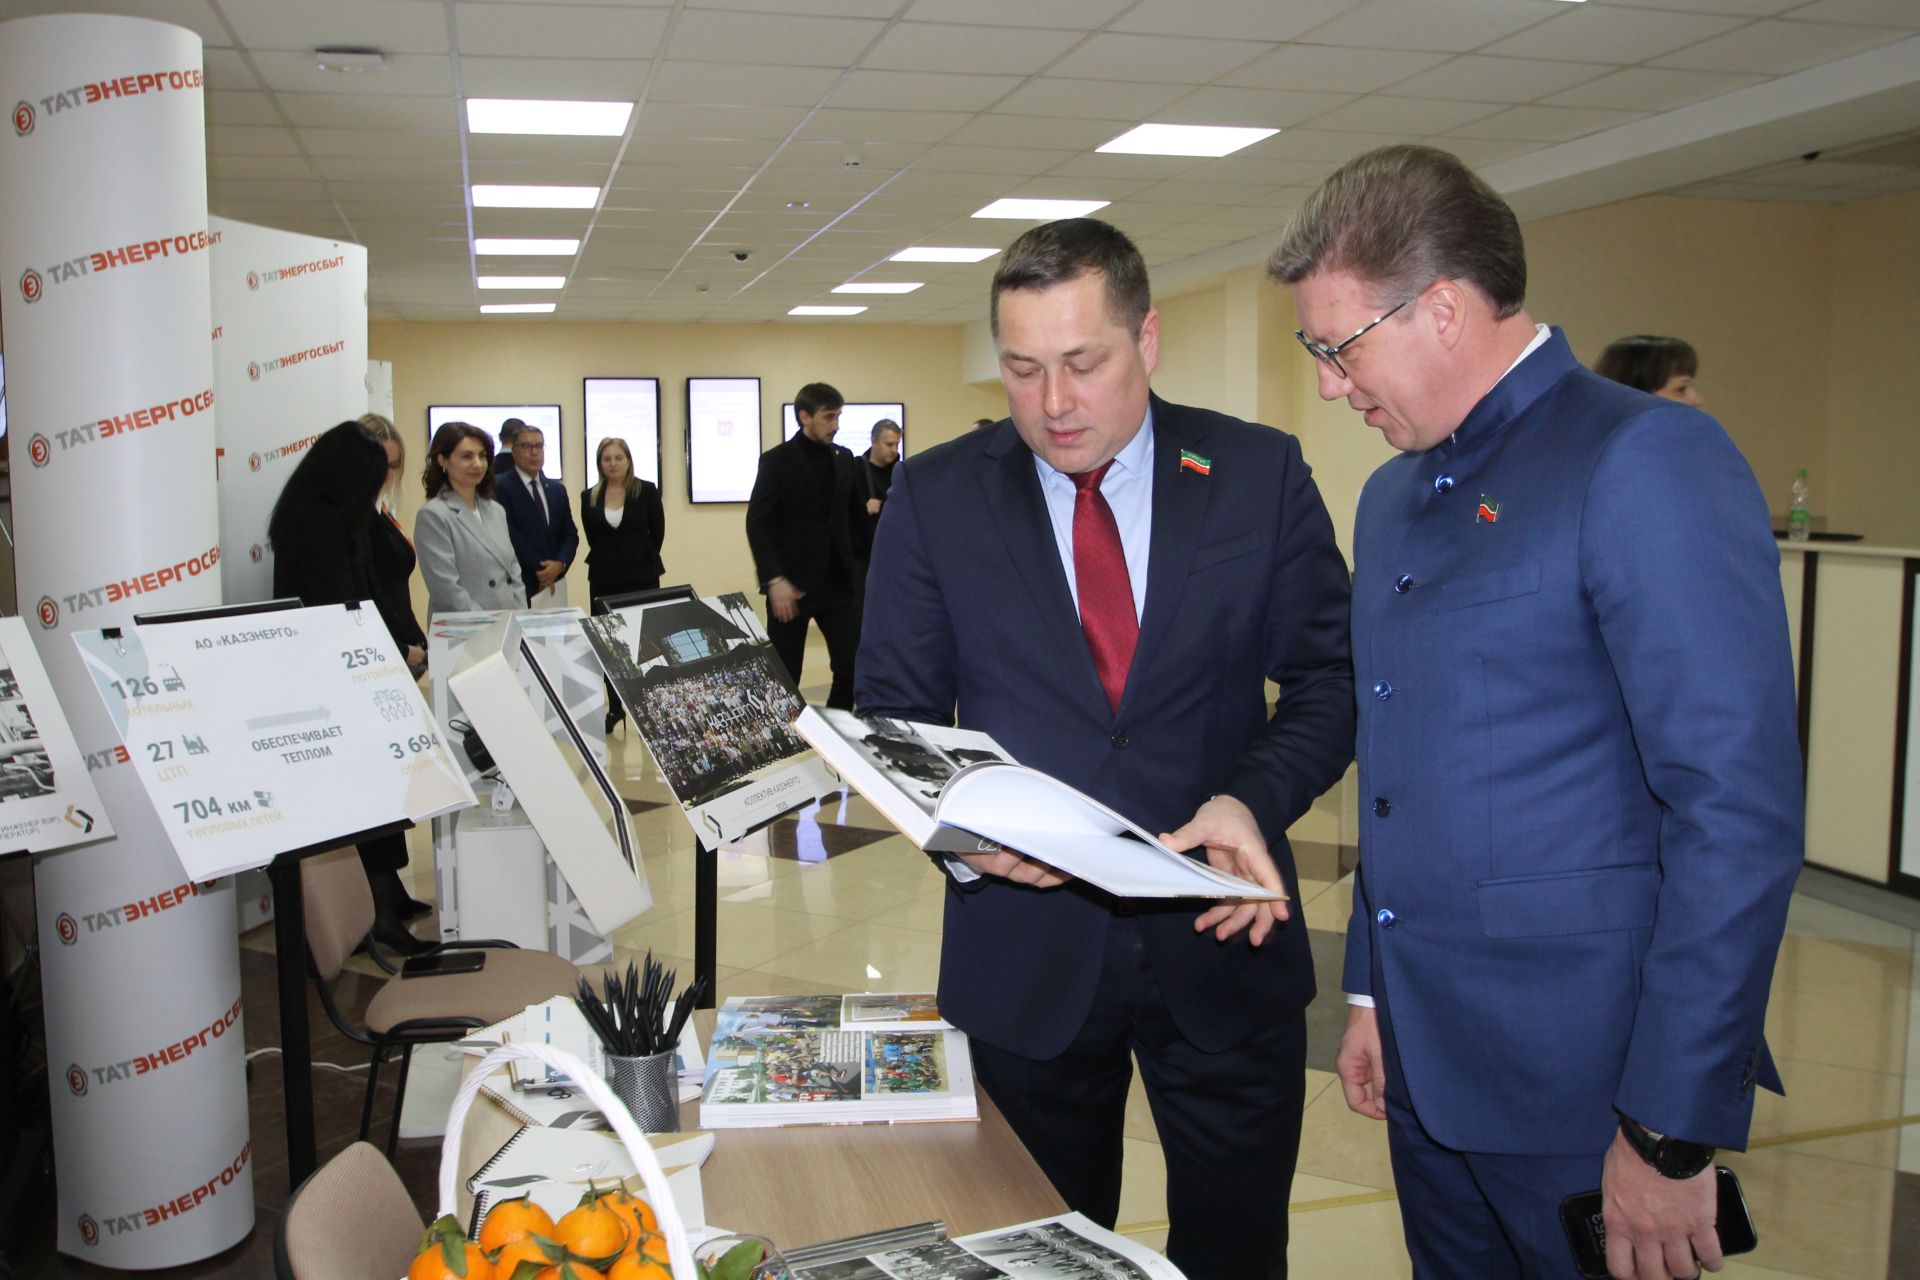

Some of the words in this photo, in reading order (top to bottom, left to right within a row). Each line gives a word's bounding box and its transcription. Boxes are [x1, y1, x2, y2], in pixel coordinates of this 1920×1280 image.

[261, 255, 345, 284] ТАТЭНЕРГОСБЫТ
[262, 340, 345, 374] ТАТЭНЕРГОСБЫТ
[263, 432, 325, 464] ТАТЭНЕРГО
[194, 637, 214, 651] АО
[341, 647, 387, 670] 25%
[110, 675, 159, 700] 126
[147, 740, 175, 763] 27
[251, 725, 344, 753] ОБЕСПЕЧИВАЕТ
[281, 745, 334, 765] ТЕПЛОМ
[156, 764, 189, 783] ЦТП
[173, 796, 224, 825] 704
